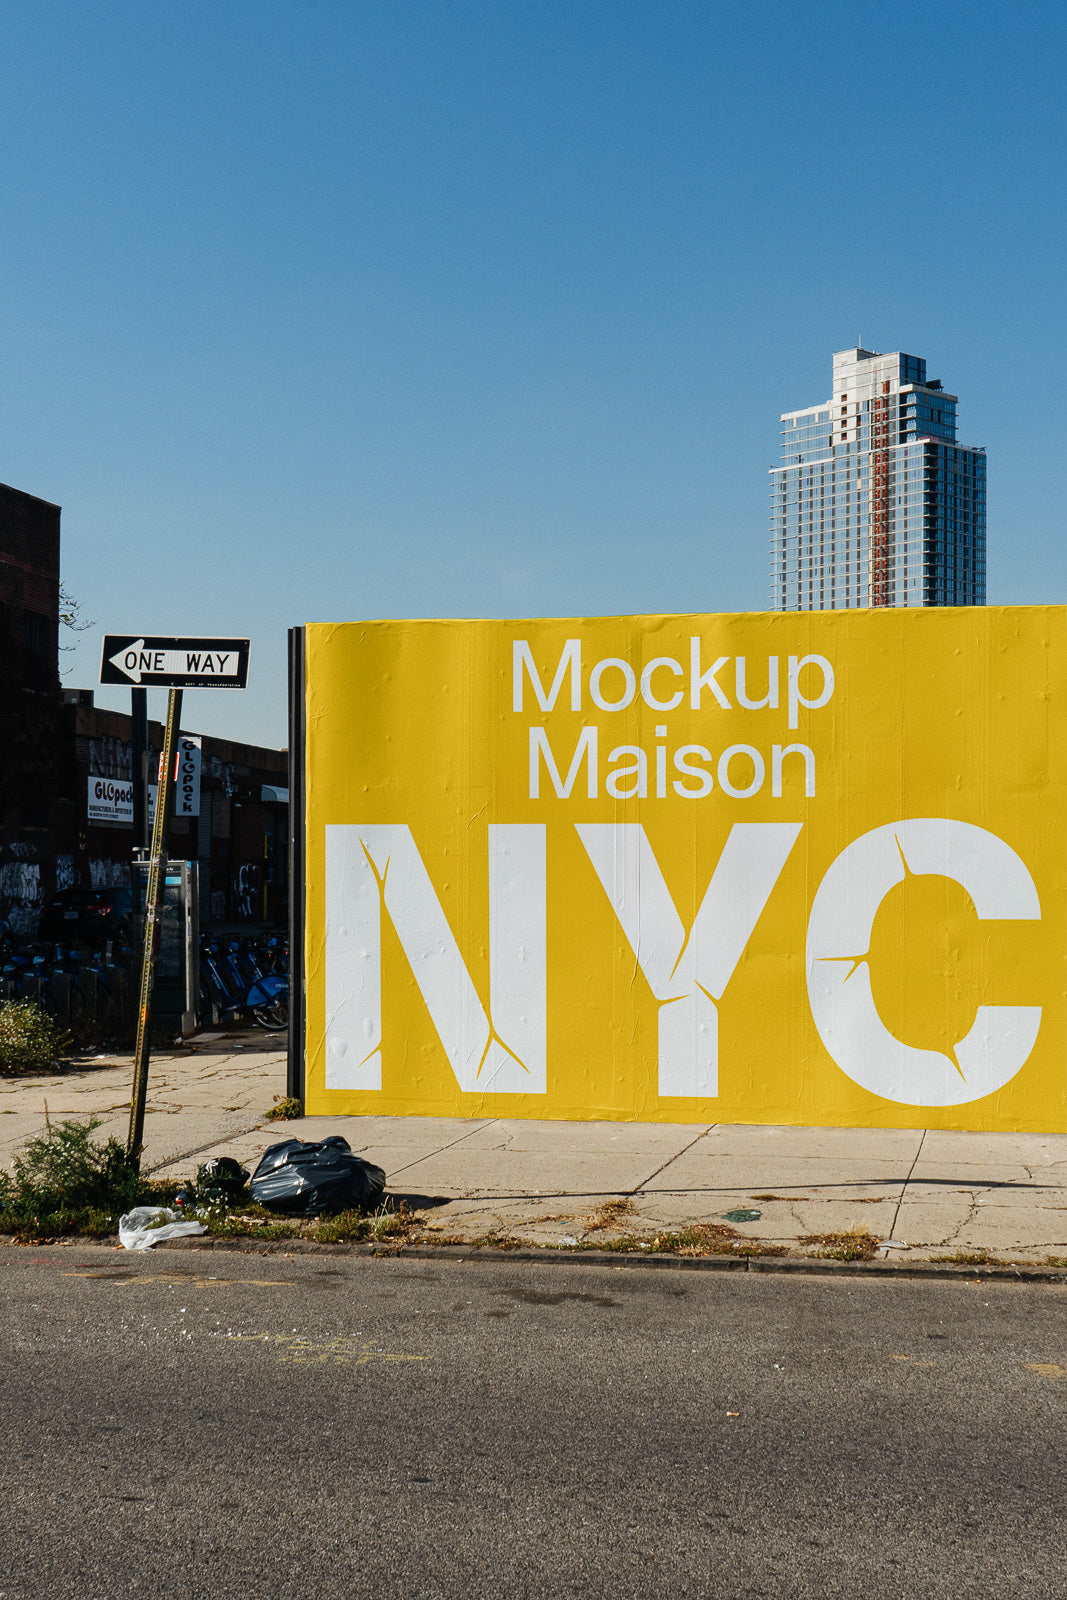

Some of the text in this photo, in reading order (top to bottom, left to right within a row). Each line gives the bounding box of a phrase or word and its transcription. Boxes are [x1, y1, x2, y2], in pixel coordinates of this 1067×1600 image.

[124, 651, 229, 673] ONE WAY
[513, 637, 834, 729] Mockup
[529, 725, 815, 799] Maison
[325, 818, 1043, 1107] NYC
